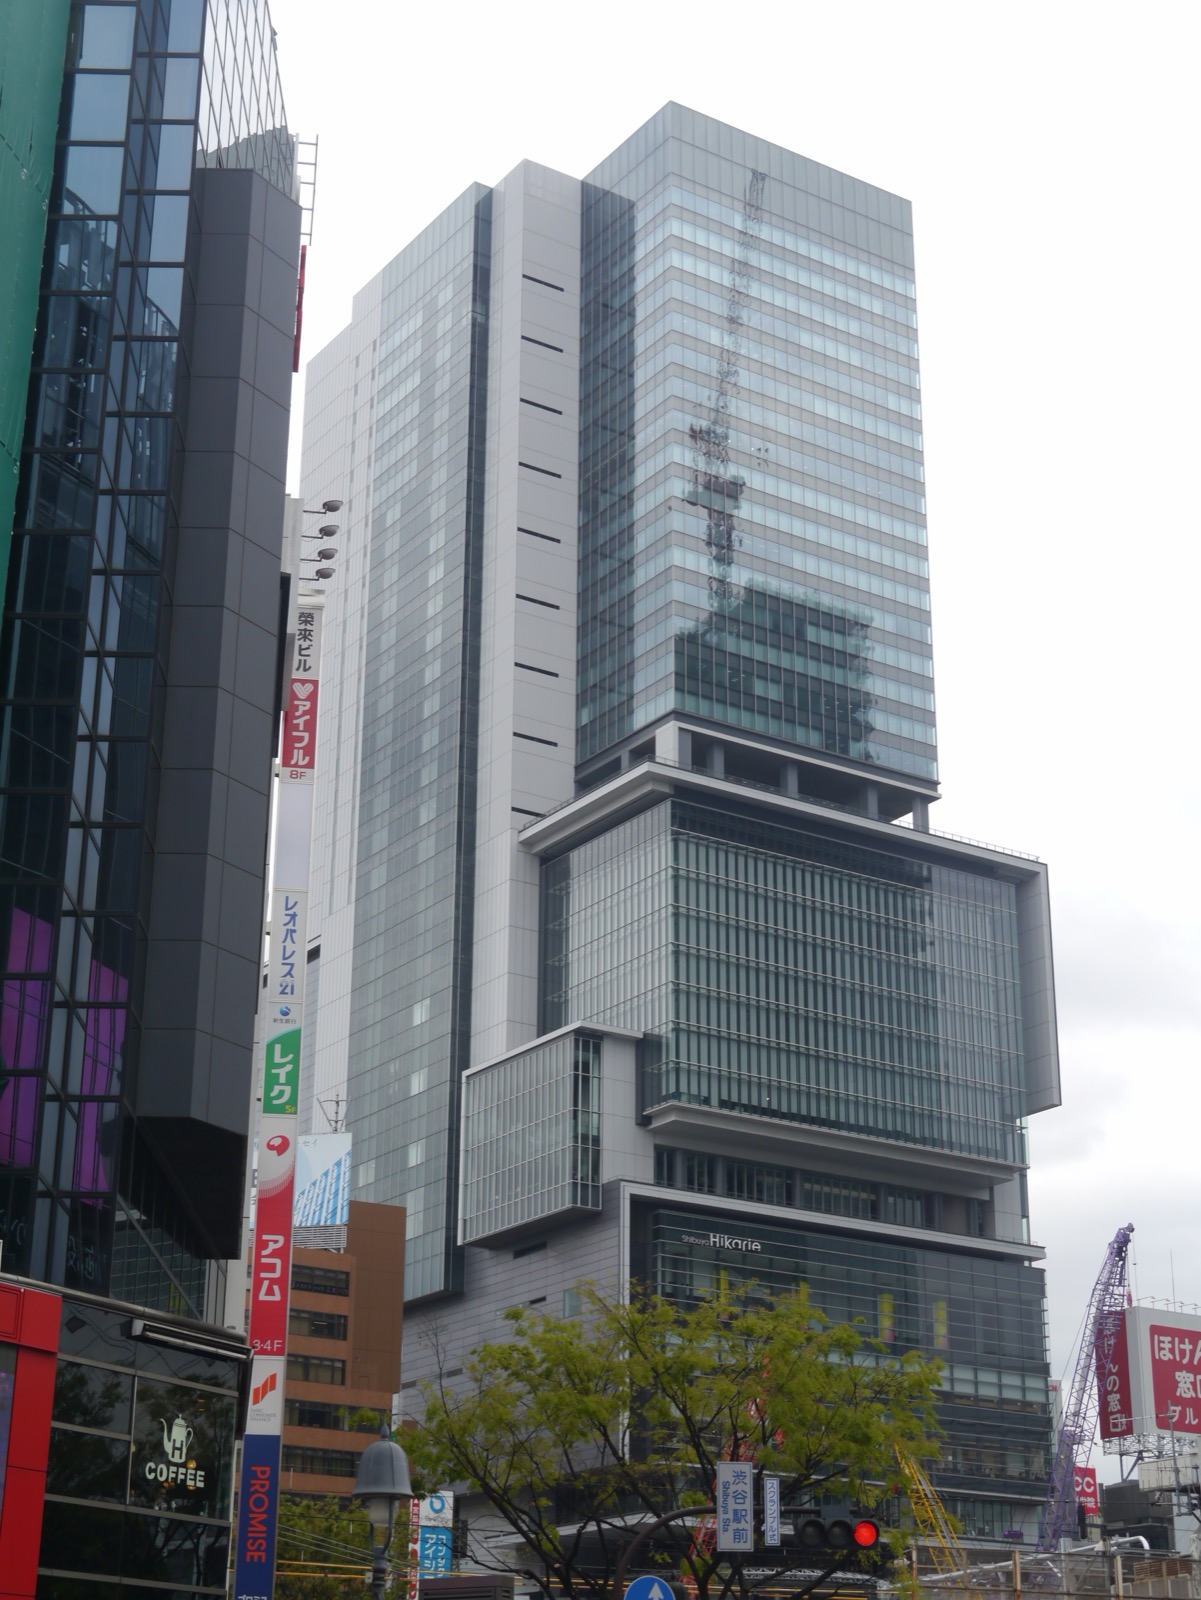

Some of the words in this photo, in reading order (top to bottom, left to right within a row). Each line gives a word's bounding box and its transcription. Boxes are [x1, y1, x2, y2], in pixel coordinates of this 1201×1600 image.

[290, 700, 311, 766] アイフル
[289, 769, 307, 780] 8F
[278, 895, 299, 996] レオパレス21
[269, 1043, 294, 1105] レイク
[285, 1105, 297, 1114] 5F
[709, 1232, 762, 1252] Hikarie
[258, 1234, 285, 1302] アコム
[1174, 1370, 1201, 1399] 窓
[171, 1438, 185, 1460] H
[145, 1462, 205, 1488] COFFEE
[245, 1466, 271, 1563] PROMISE
[721, 1481, 731, 1515] Shibuya
[732, 1470, 749, 1544] 渋谷駅前
[767, 1482, 777, 1542] スクランブル式
[722, 1518, 731, 1535] Sta.
